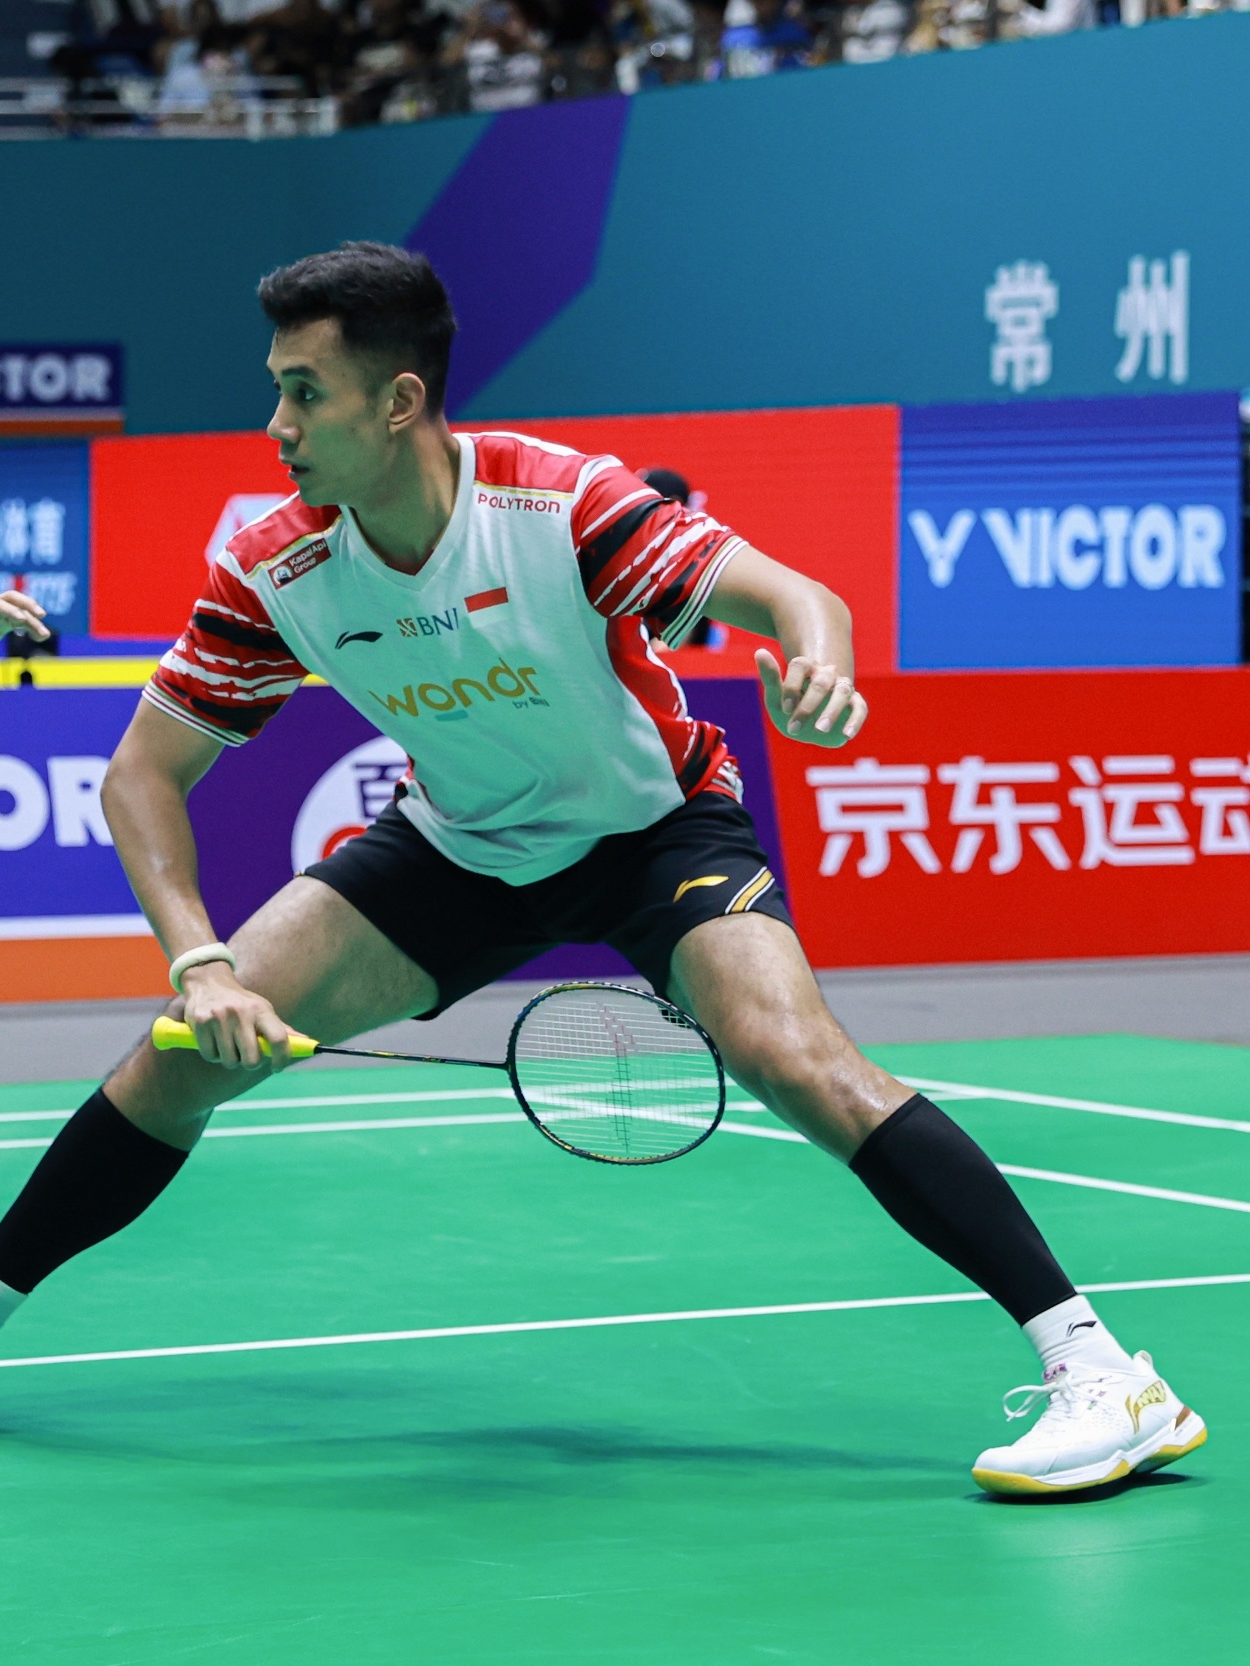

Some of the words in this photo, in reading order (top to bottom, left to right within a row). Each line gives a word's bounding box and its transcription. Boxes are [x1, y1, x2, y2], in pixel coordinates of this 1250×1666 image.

[985, 249, 1189, 391] 常州
[478, 493, 560, 513] POLYTRON
[982, 505, 1226, 589] VICTOR
[417, 608, 460, 636] BNI
[368, 657, 541, 717] wondr
